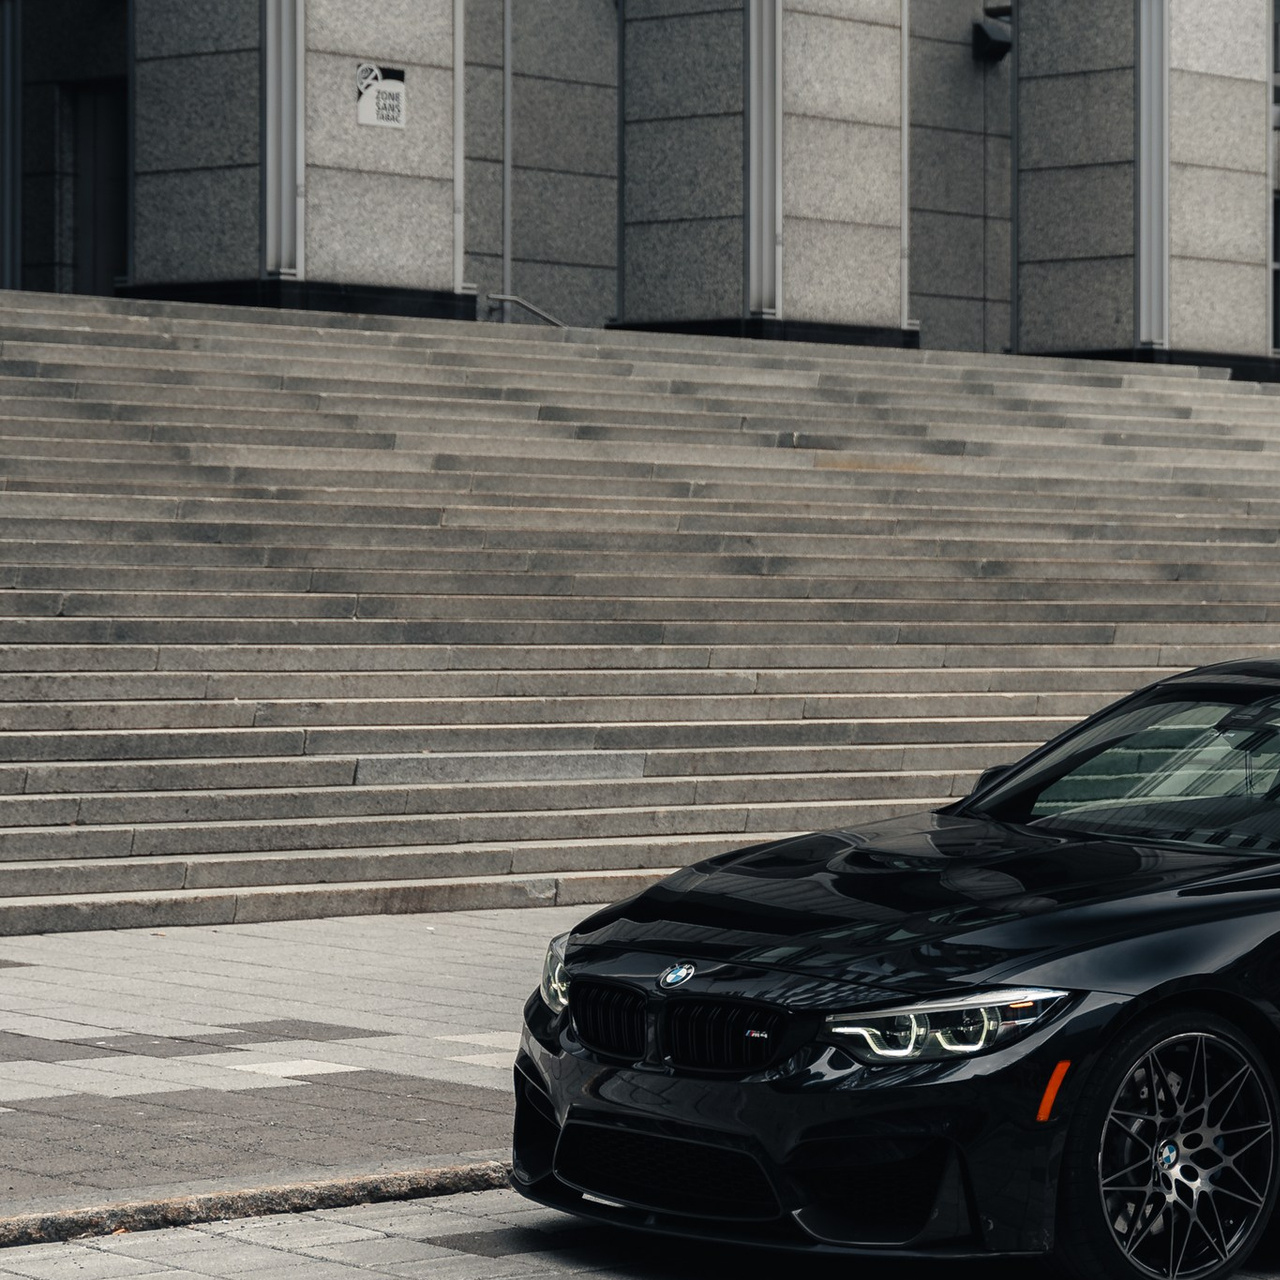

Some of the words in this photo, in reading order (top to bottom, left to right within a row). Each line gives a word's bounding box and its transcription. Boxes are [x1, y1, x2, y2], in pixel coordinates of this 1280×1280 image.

[376, 90, 400, 102] ZONE
[376, 101, 401, 113] SANS
[376, 110, 401, 123] TABAC
